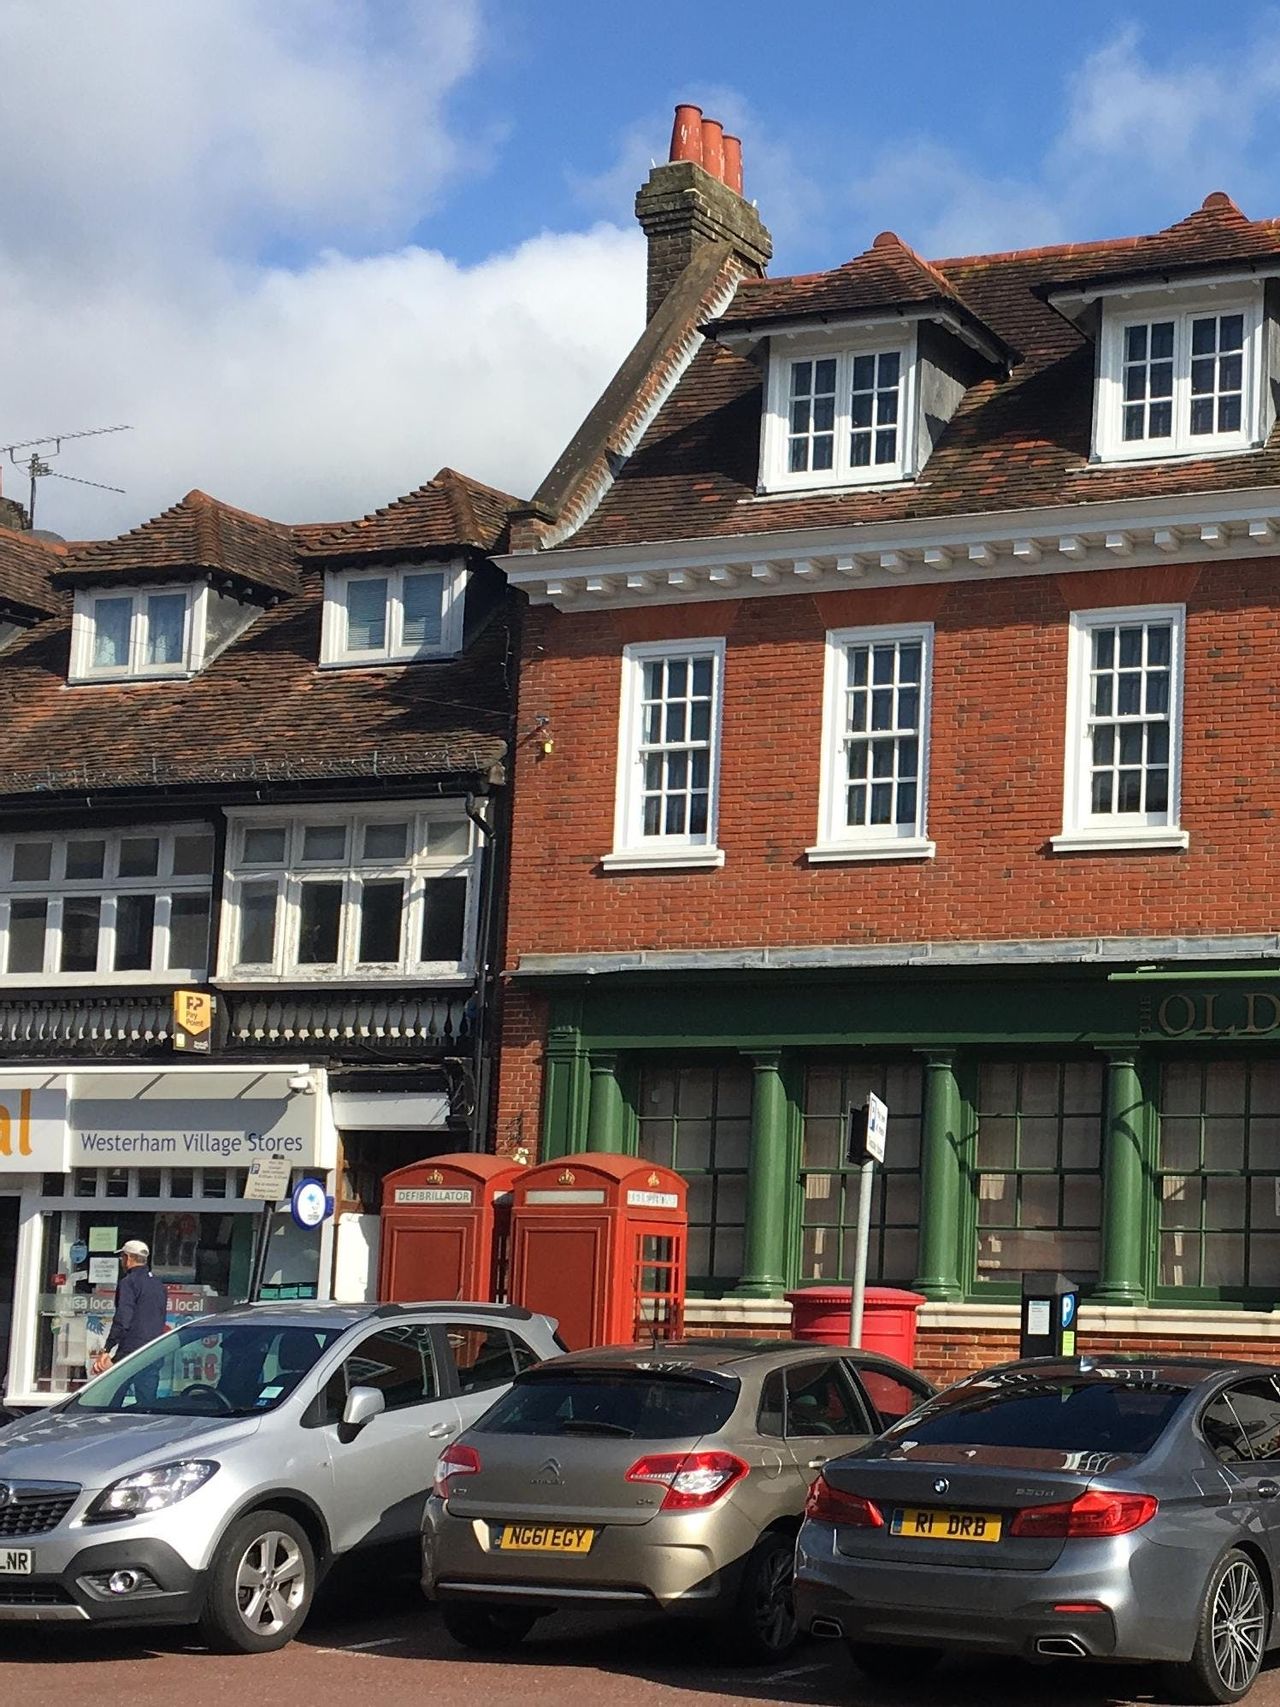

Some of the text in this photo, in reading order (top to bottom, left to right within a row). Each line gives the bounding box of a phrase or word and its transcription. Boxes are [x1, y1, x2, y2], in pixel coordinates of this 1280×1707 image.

[81, 1133, 303, 1156] Westerham Village Stores
[398, 1191, 470, 1201] DEFIBRILLATOR
[175, 1298, 204, 1312] local
[1062, 1296, 1072, 1321] P
[947, 1514, 986, 1537] DRB
[509, 1527, 587, 1547] NG61 EGY
